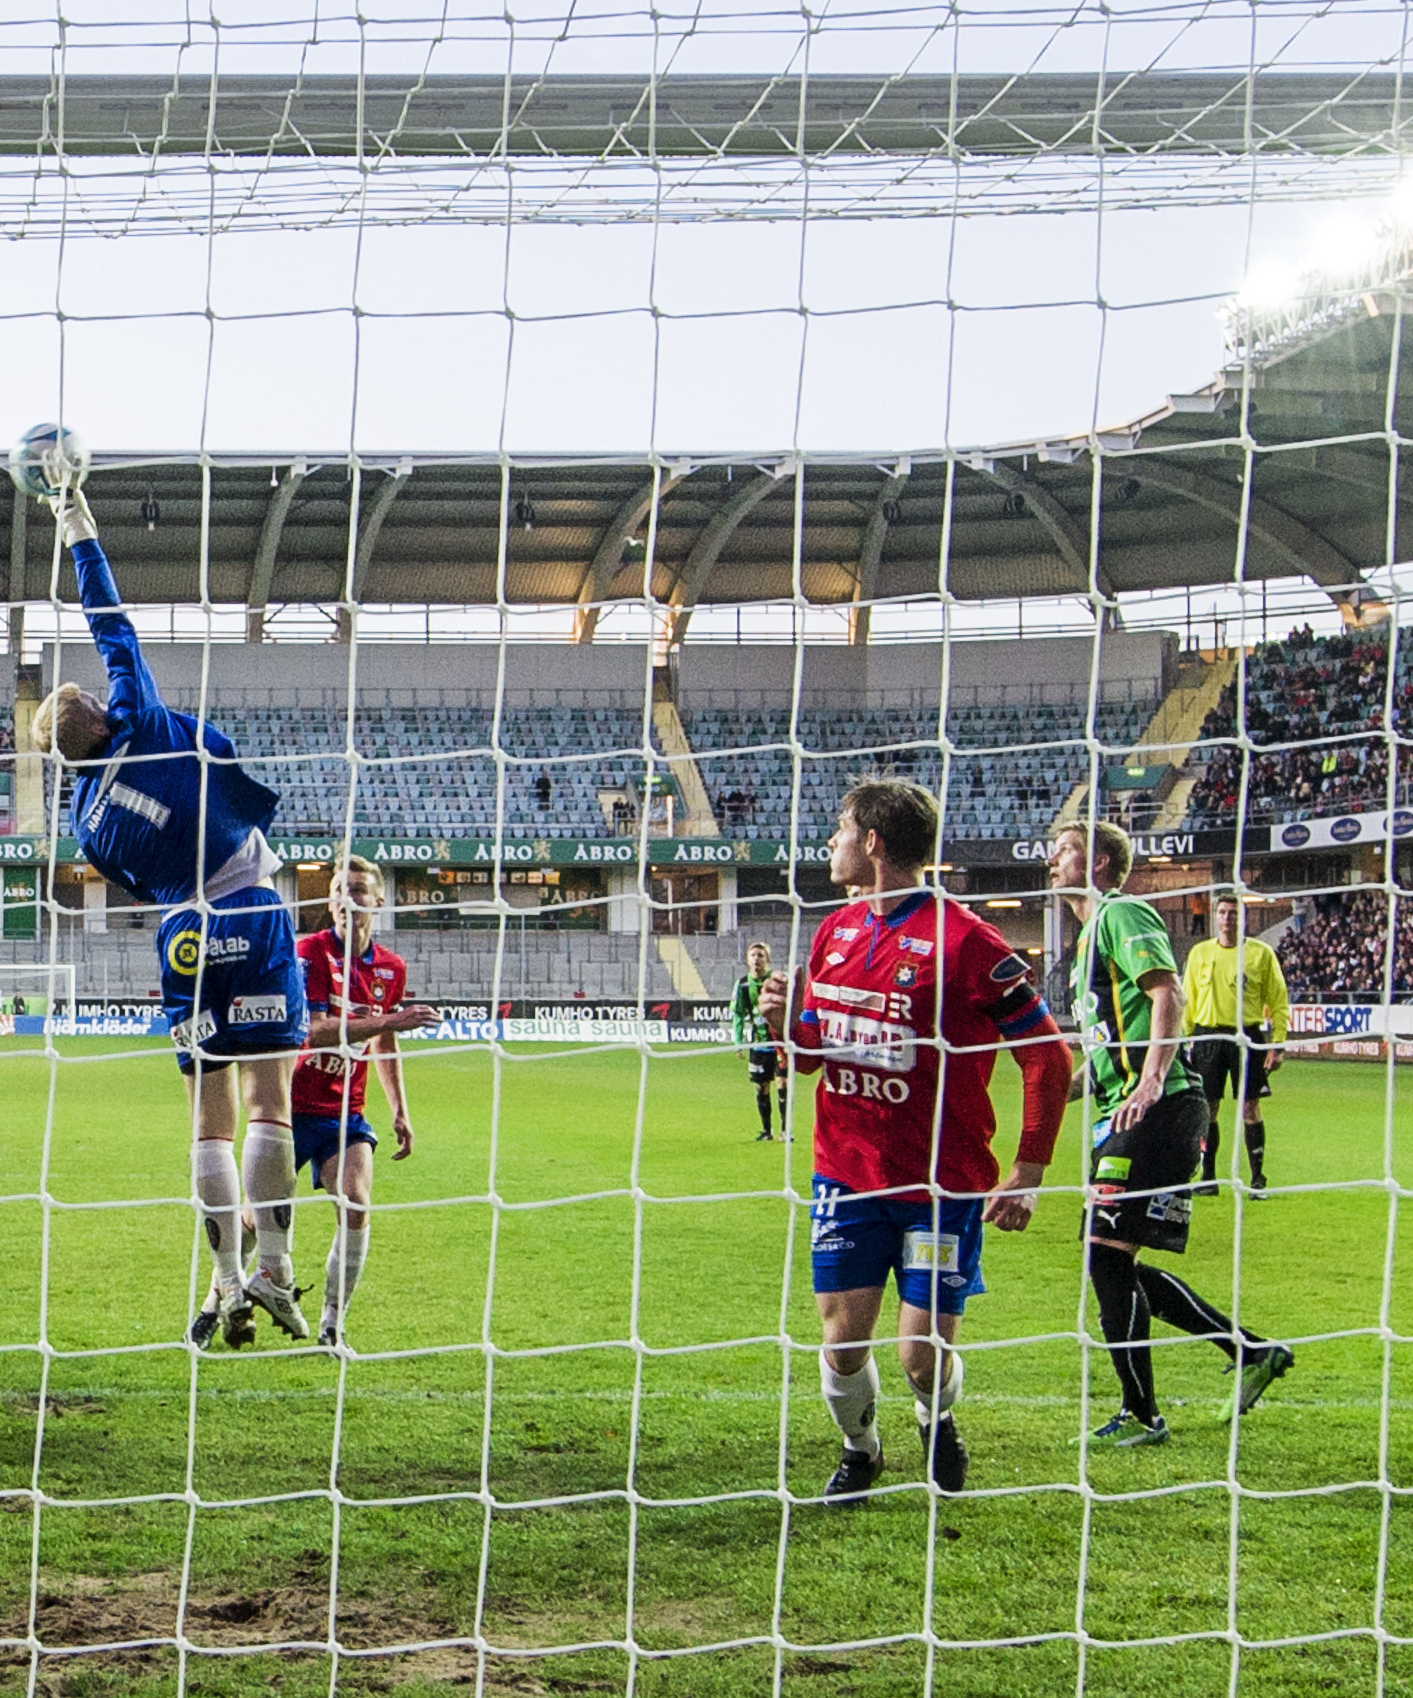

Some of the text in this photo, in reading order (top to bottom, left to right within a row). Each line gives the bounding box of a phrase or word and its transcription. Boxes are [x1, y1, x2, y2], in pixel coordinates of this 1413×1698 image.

[276, 842, 333, 860] ÅBRO
[374, 842, 432, 861] ÅBRO
[573, 843, 632, 861] ÅBRO
[673, 843, 733, 861] ÅBRO
[233, 1006, 285, 1021] RASTA
[535, 1006, 645, 1021] KUMHO TYRES
[1286, 1006, 1372, 1033] NTERSPORT
[175, 1021, 214, 1047] RATA
[510, 1018, 580, 1035] sauna
[670, 1027, 727, 1041] KUMHO
